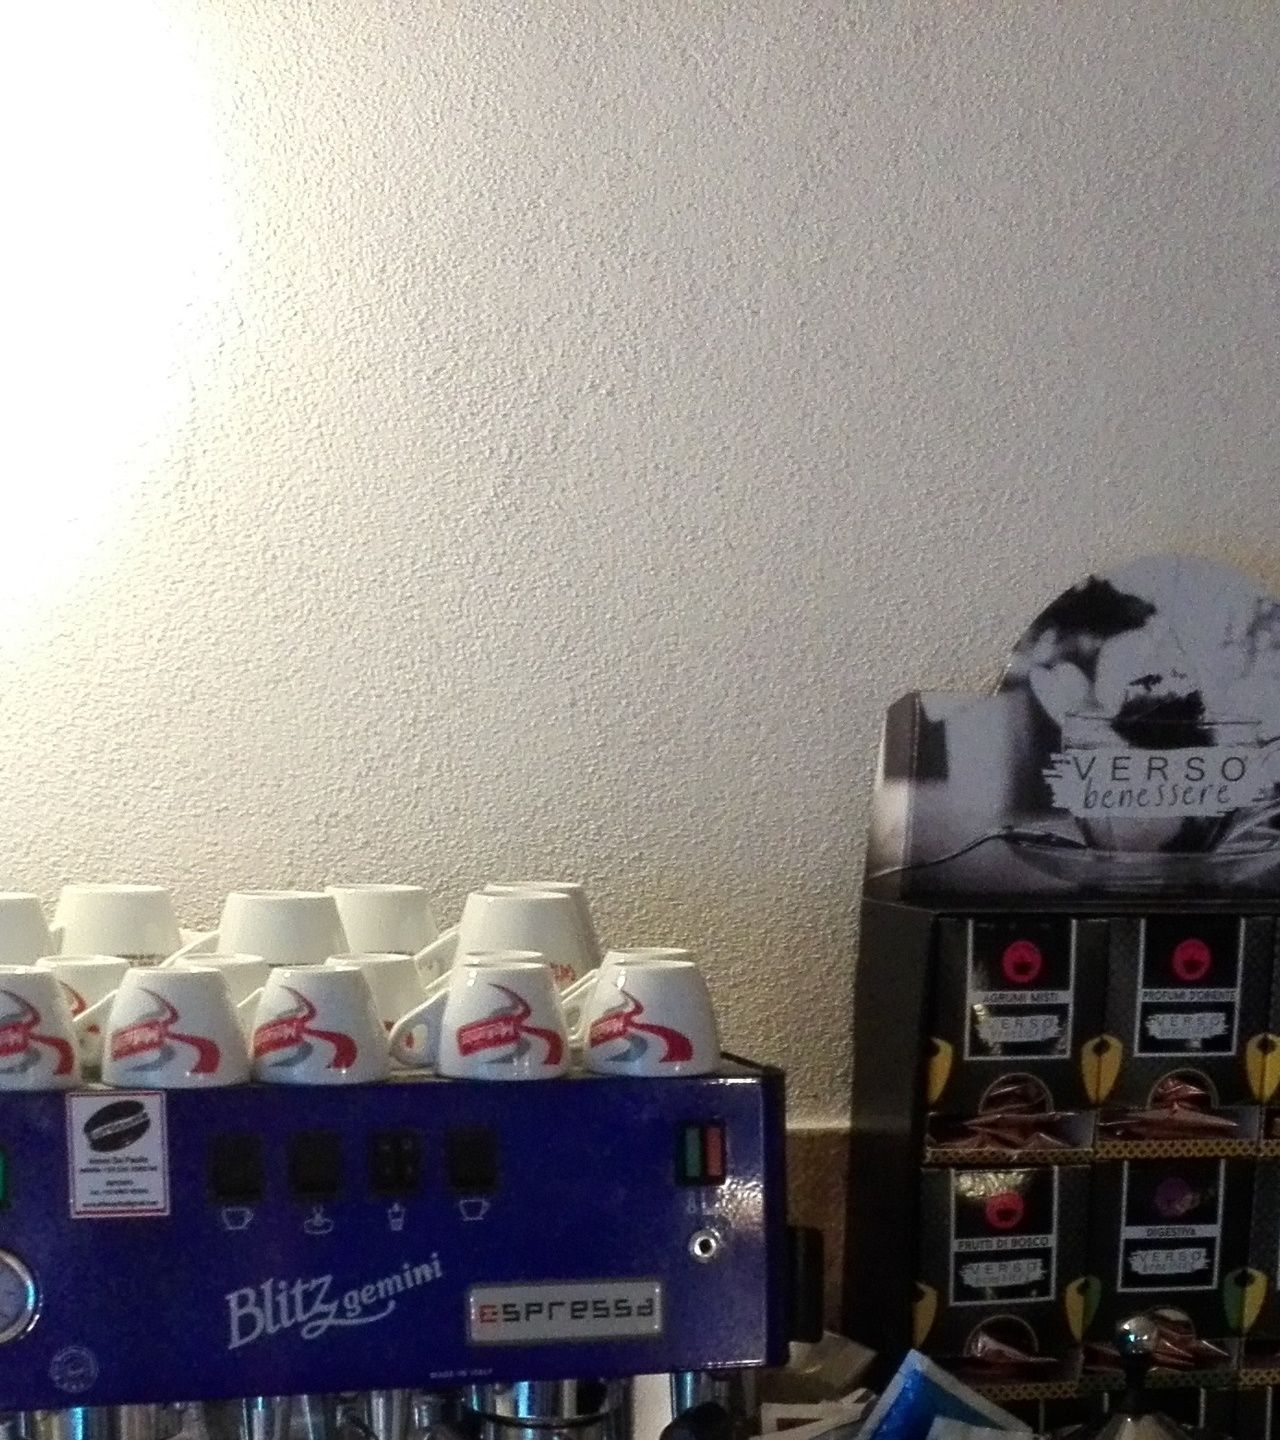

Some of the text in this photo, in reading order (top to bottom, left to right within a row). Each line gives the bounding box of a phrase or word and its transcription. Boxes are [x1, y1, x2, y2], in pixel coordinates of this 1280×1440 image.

[1072, 755, 1246, 783] VERSO
[1083, 778, 1232, 810] benessere
[996, 1237, 1008, 1249] DI
[1010, 1235, 1049, 1248] BOSCO
[225, 1252, 443, 1350] Blitz gemini
